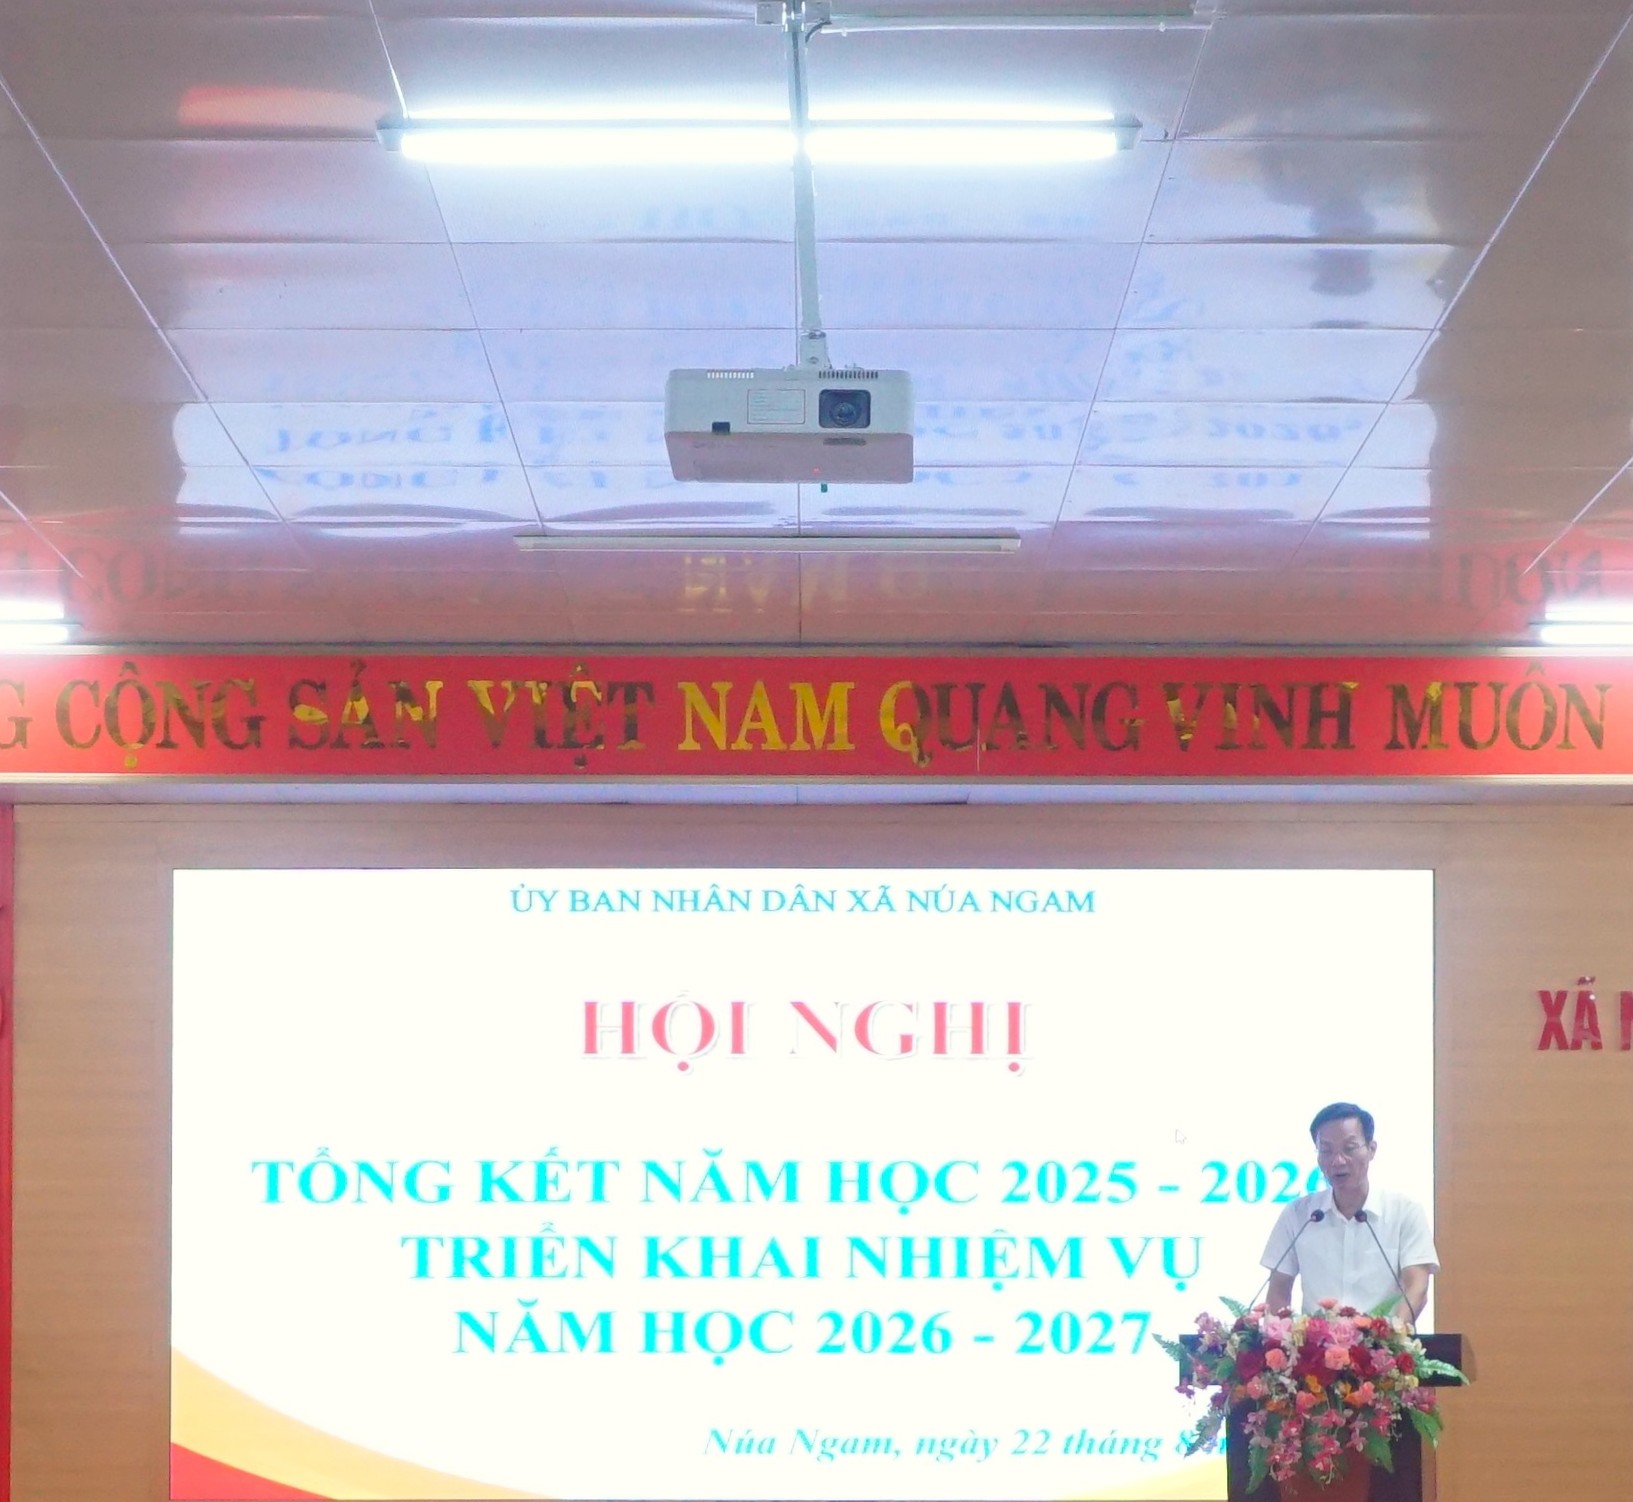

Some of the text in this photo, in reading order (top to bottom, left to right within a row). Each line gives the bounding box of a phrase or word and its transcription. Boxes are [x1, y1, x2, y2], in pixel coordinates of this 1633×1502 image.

[55, 659, 262, 769] CỘNG
[287, 659, 440, 751] SẢN
[467, 662, 655, 769] VIỆT
[677, 680, 856, 752] NAM
[879, 680, 1144, 768] QUANG
[1160, 680, 1359, 753] VINH
[1386, 660, 1612, 753] MUÔN
[511, 883, 1095, 913] ỦY BAN NHÂN DÂN XÃ NÚA NGAM
[582, 994, 1030, 1075] HỘI NGHỊ
[1538, 976, 1603, 1051] XÃ
[251, 1147, 453, 1204] TỔNG
[477, 1146, 620, 1204] KẾT
[641, 1148, 799, 1204] NĂM
[827, 1160, 980, 1216] HỌC
[1001, 1160, 1138, 1205] 2025
[400, 1222, 1202, 1292] TRIỂN KHAI NHIỆM VỤ
[455, 1298, 615, 1354] NĂM
[641, 1309, 794, 1367] HỌC
[816, 1309, 953, 1355] 2026
[1016, 1310, 1152, 1355] 2027
[705, 1428, 776, 1455] Núa
[790, 1428, 902, 1462] Ngam,
[916, 1430, 998, 1462] ngày
[1013, 1429, 1052, 1455] 22
[1062, 1429, 1163, 1461] tháng
